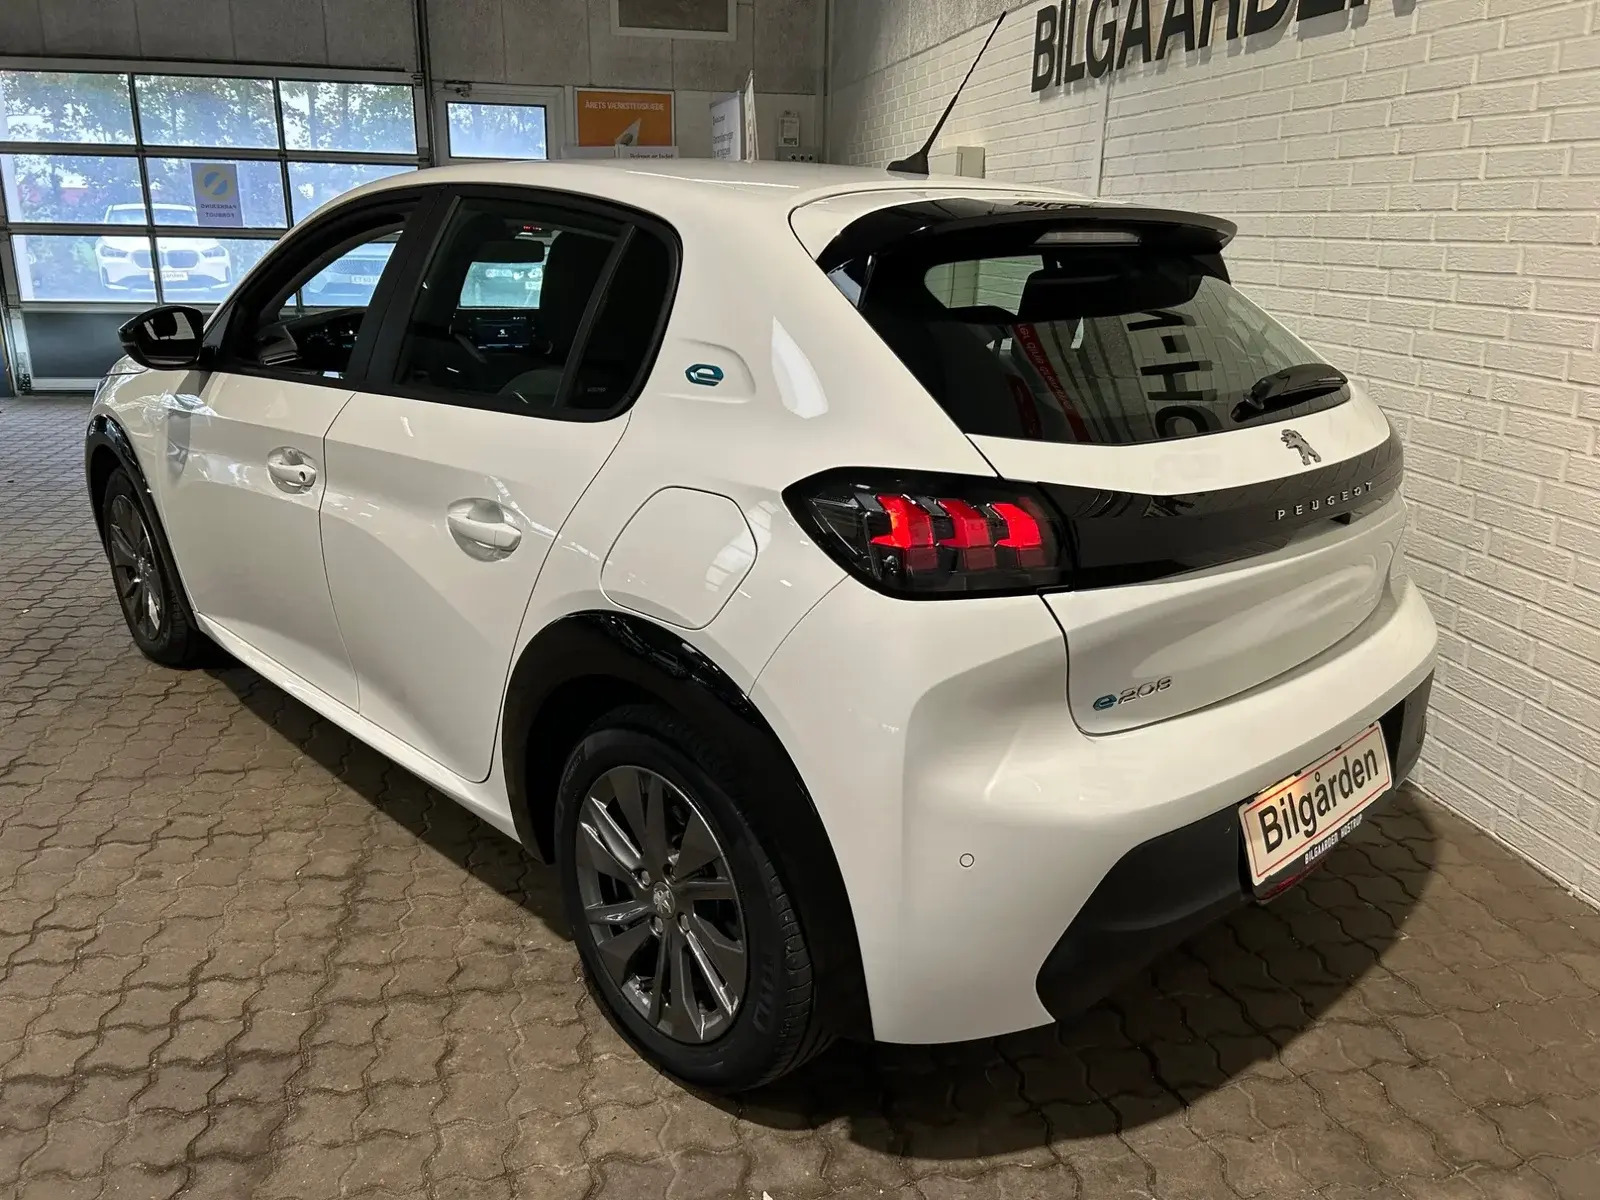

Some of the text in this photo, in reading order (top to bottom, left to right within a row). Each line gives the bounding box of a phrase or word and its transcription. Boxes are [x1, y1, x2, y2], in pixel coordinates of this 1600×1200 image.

[1031, 0, 1367, 93] BILGAA
[1275, 481, 1373, 520] PEUGEOT
[1258, 749, 1379, 854] Bilgården
[1304, 830, 1338, 865] BILGAARDEN
